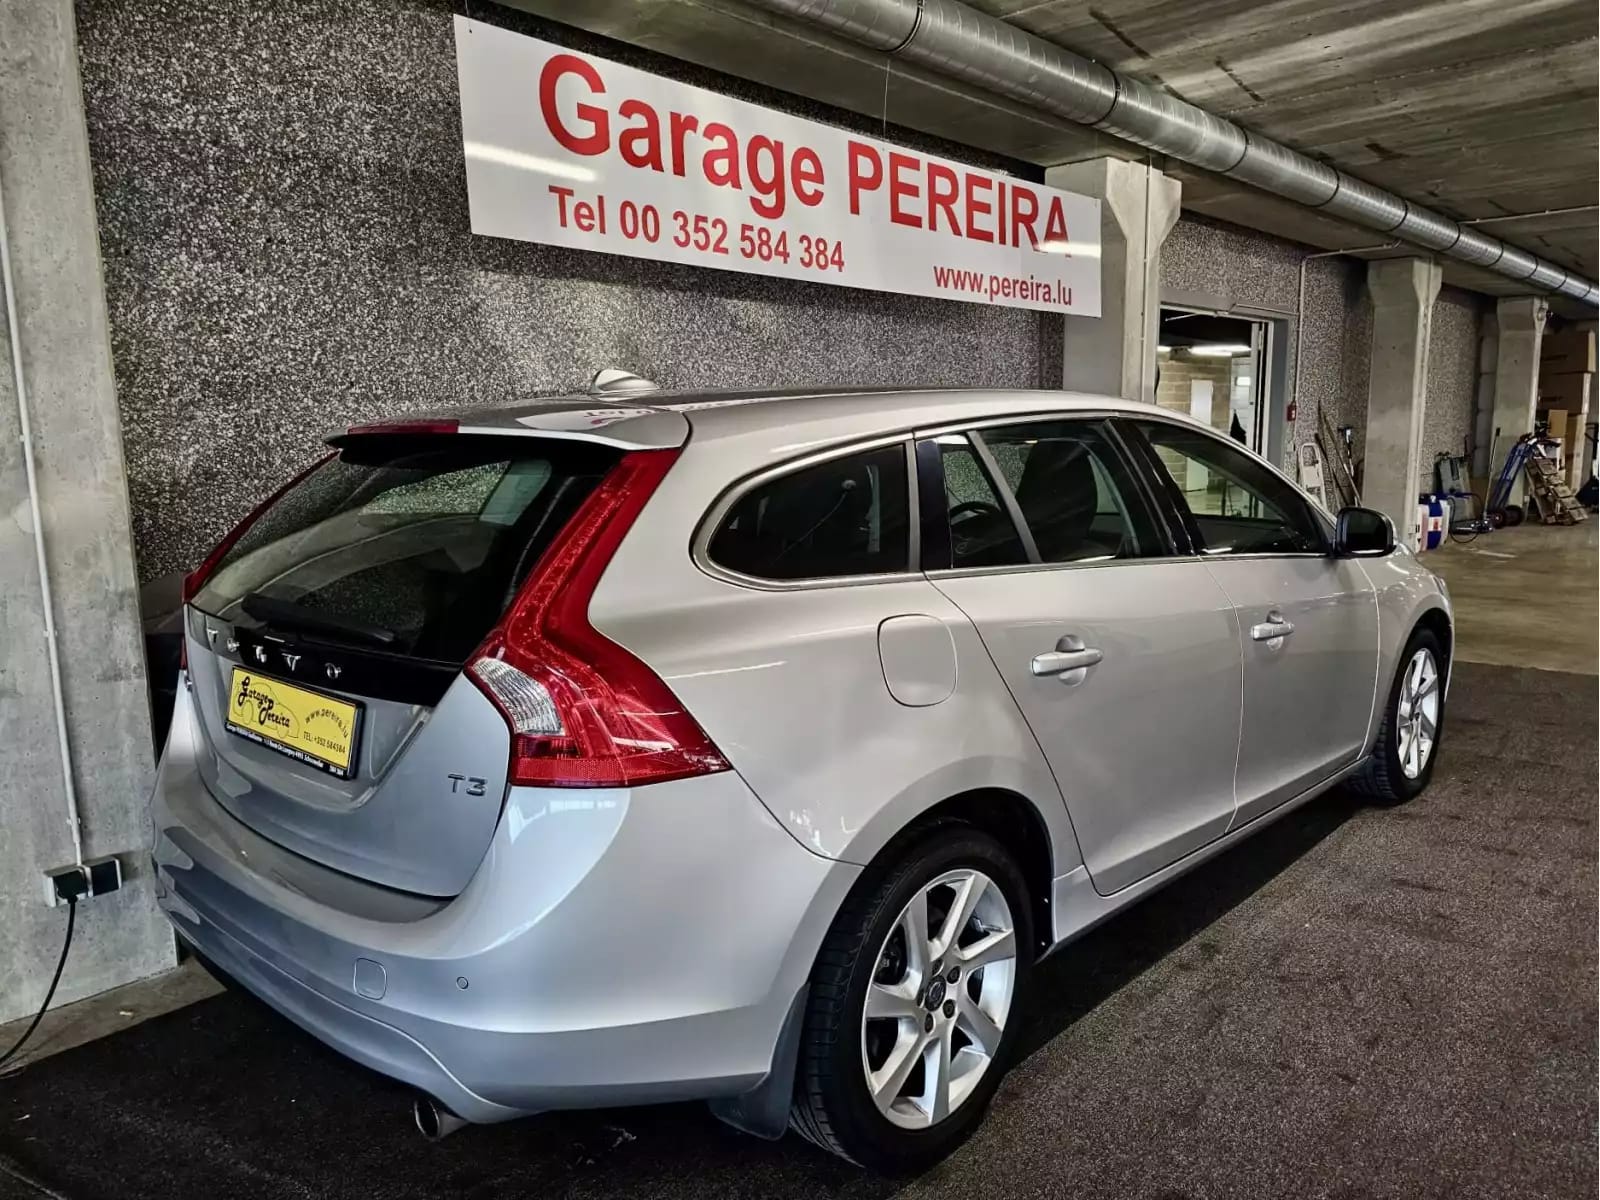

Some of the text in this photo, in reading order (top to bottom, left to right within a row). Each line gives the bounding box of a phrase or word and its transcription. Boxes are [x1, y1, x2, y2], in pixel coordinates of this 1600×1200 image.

[539, 53, 1071, 258] Garage PEREIRA
[549, 185, 845, 273] Tel 00 352 584 384
[933, 265, 1072, 306] www.pereira.lu
[238, 676, 269, 709] Garage
[258, 698, 290, 728] Pereira
[305, 708, 349, 739] www.pereira.lu
[447, 773, 487, 797] T3
